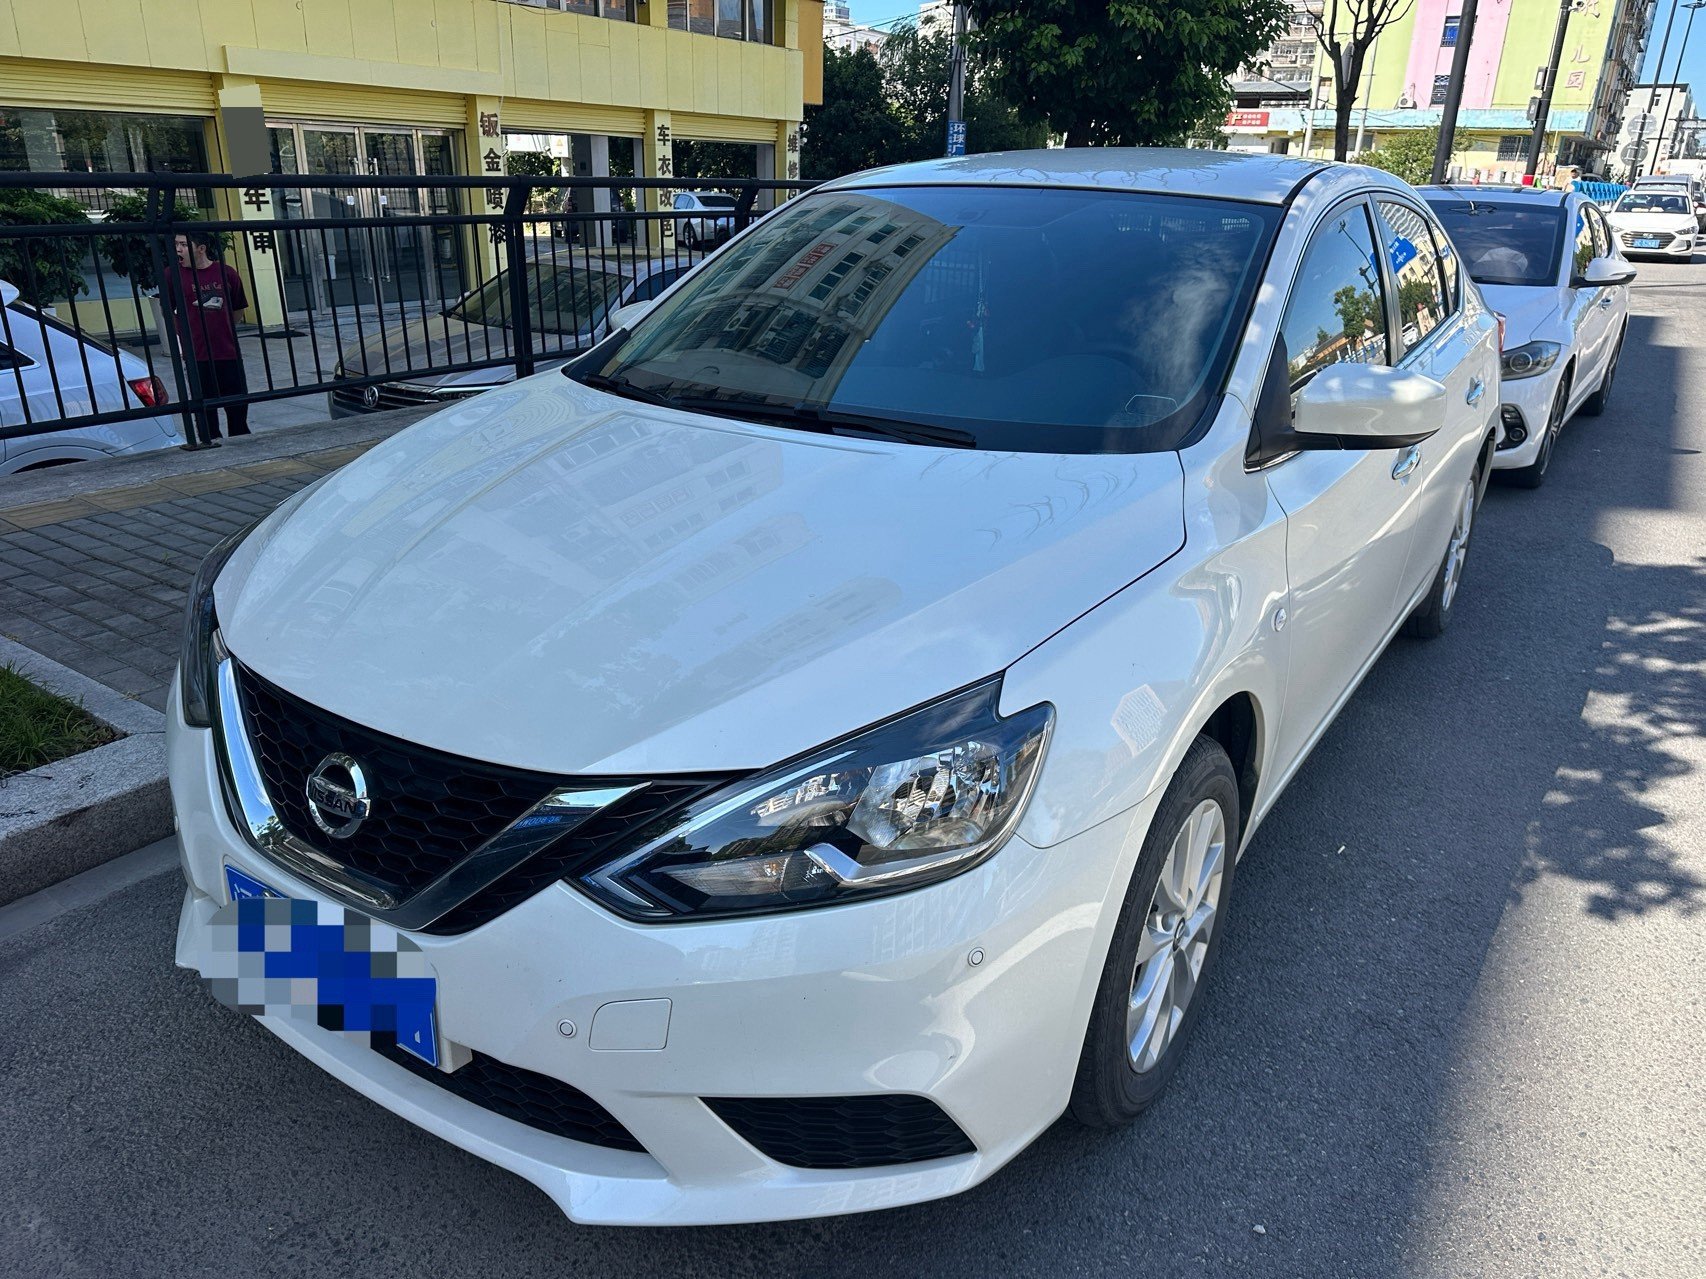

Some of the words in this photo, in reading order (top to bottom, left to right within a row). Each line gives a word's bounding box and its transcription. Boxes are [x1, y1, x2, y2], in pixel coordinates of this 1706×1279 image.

[480, 111, 506, 244] 钣金喷漆
[657, 124, 673, 237] 车衣改色
[952, 123, 965, 156] 环球广
